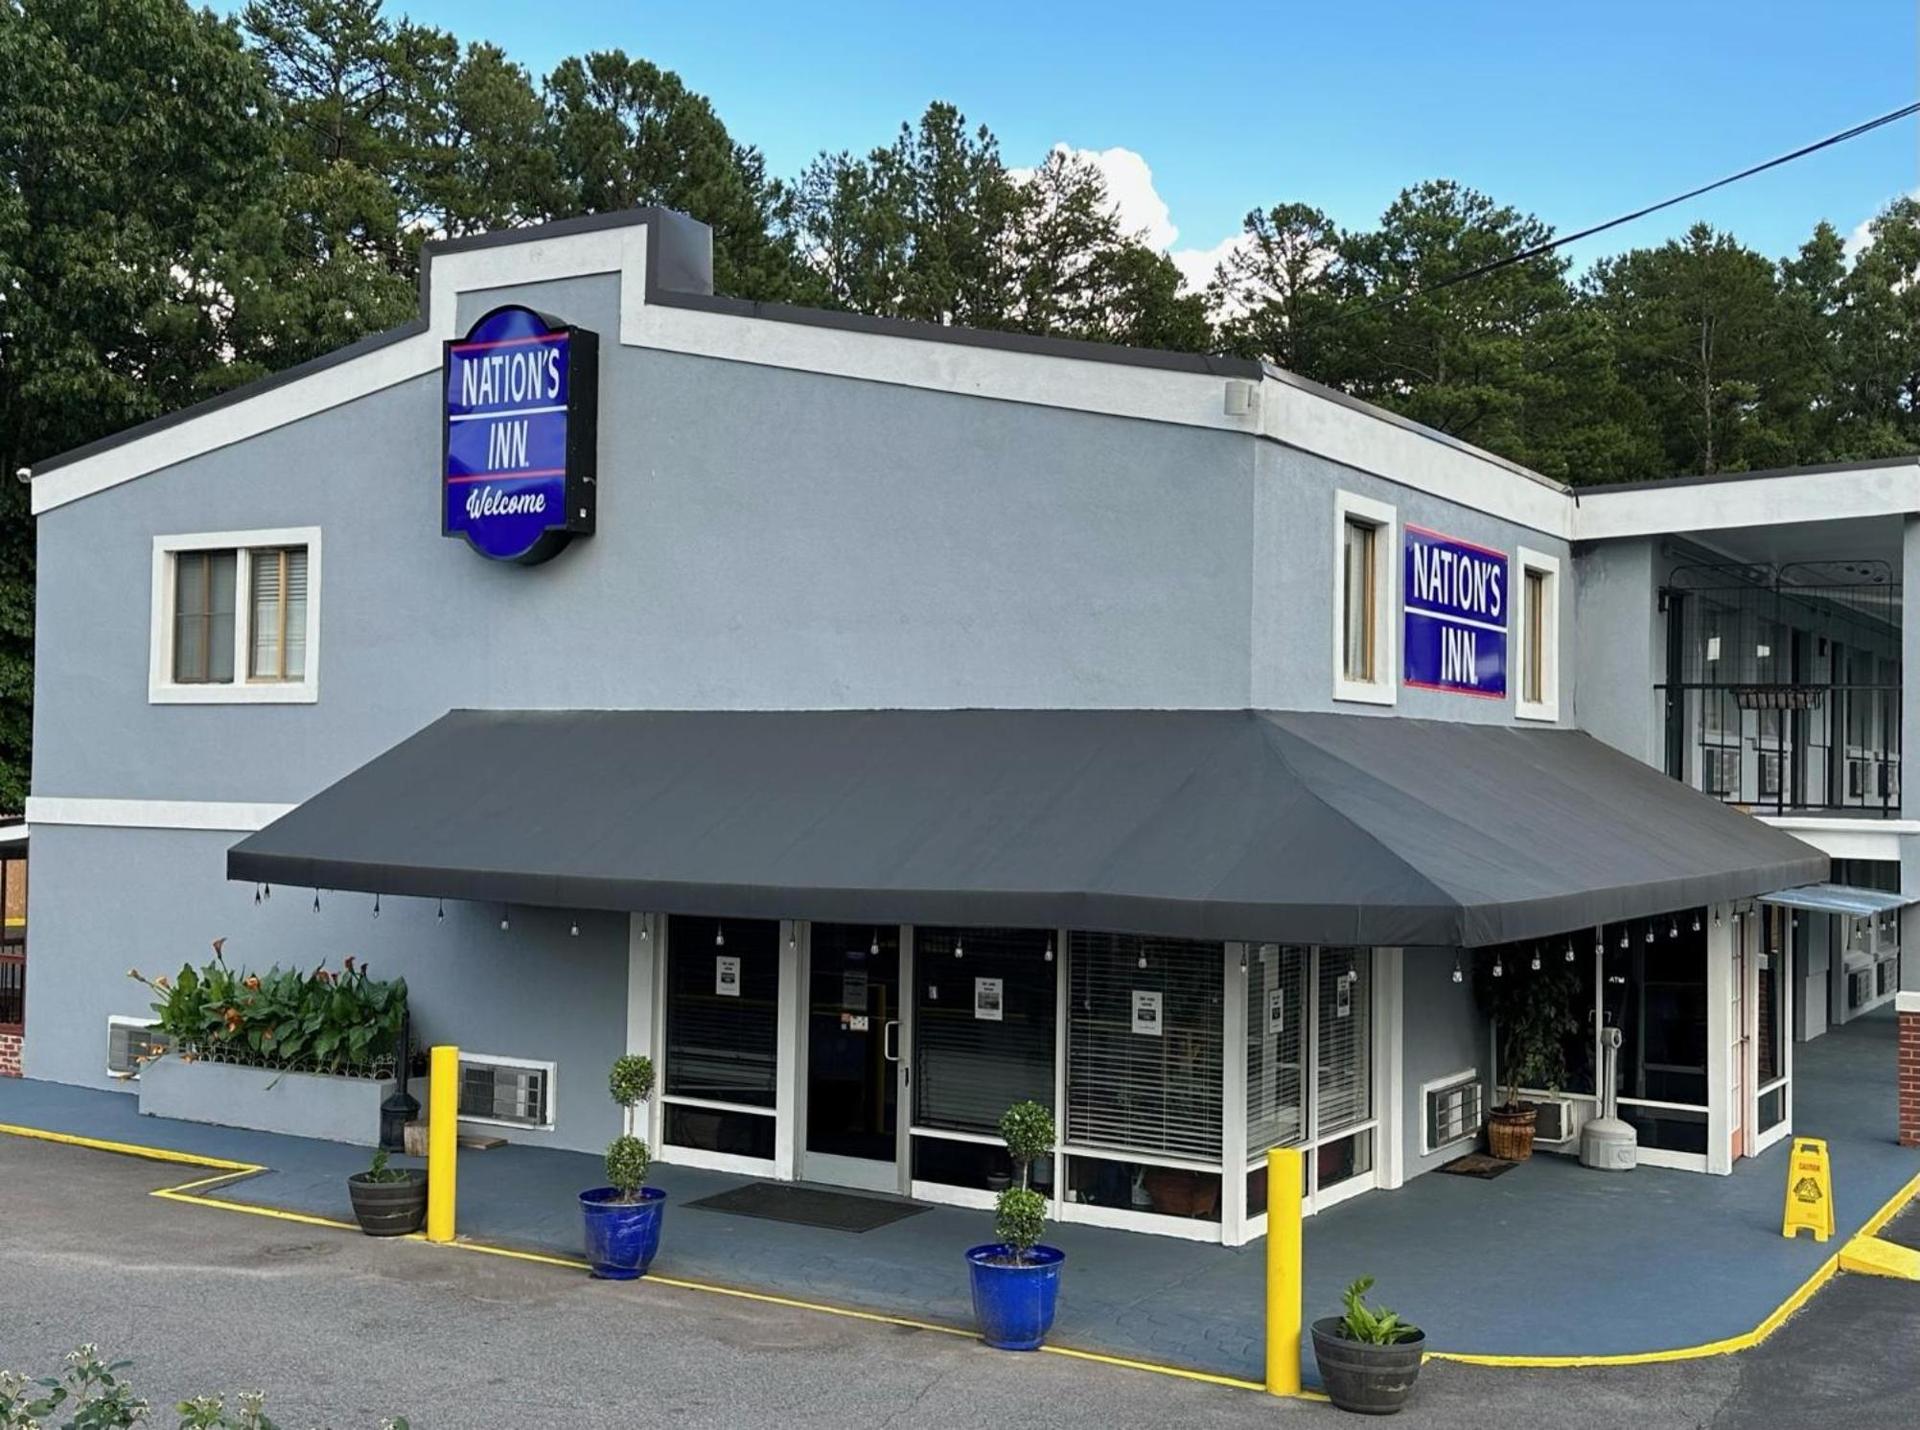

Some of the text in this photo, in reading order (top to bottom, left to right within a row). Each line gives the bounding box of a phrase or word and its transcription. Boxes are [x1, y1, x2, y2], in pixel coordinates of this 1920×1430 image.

[462, 348, 560, 406] NATION'S
[466, 486, 546, 519] Welcome
[1414, 542, 1501, 617] NATION'S
